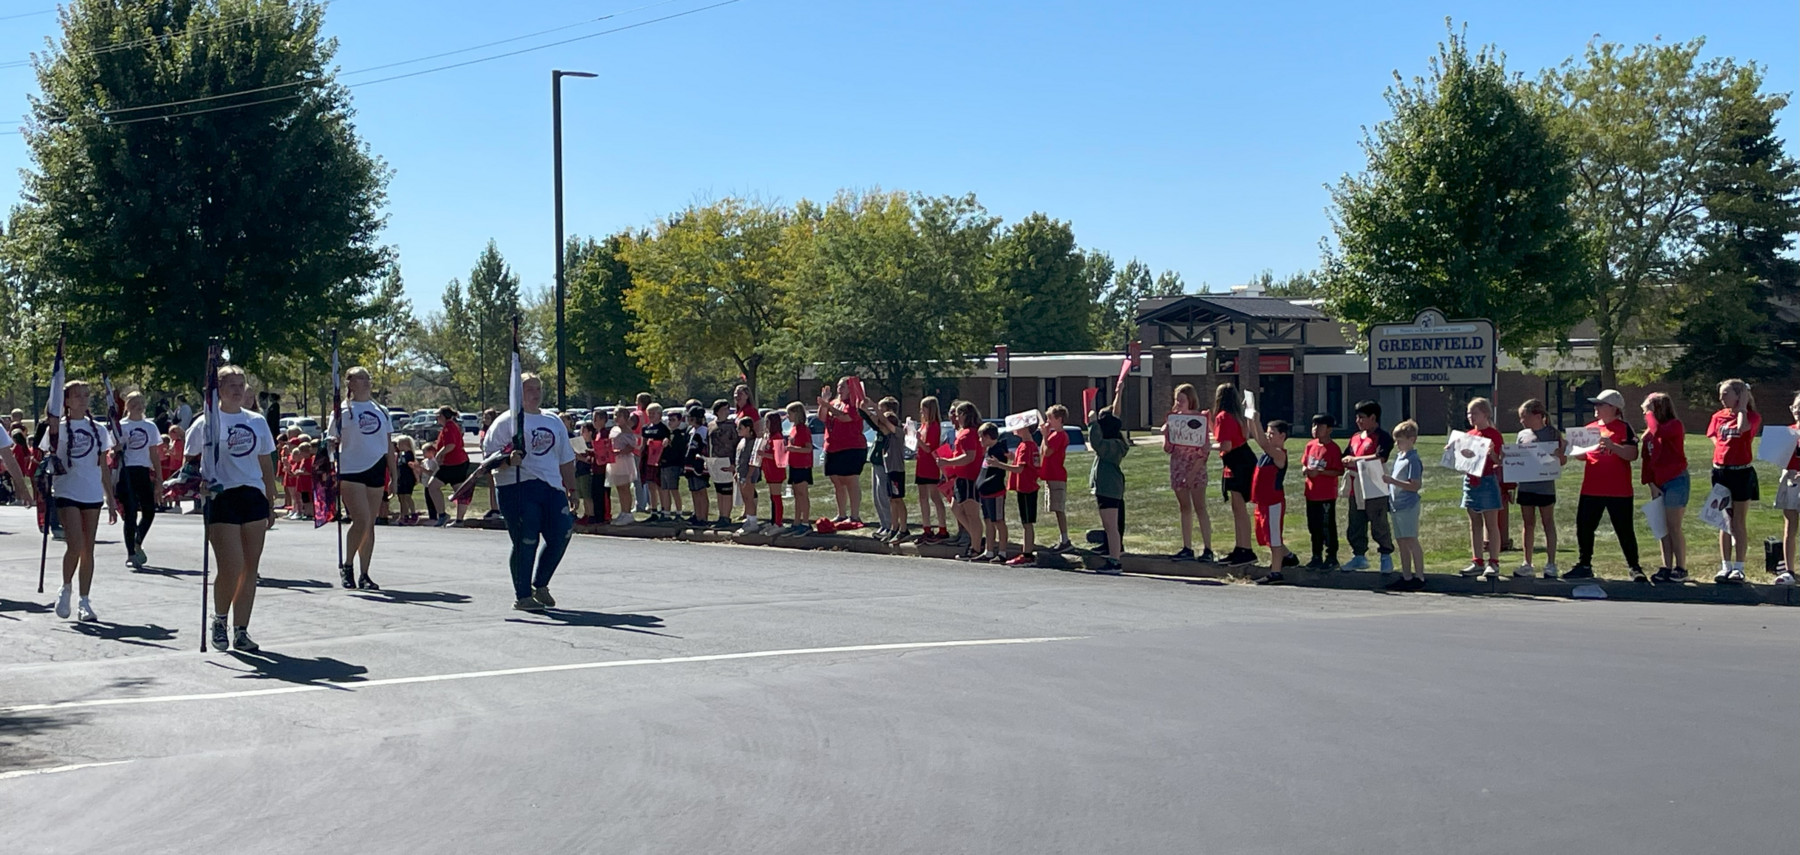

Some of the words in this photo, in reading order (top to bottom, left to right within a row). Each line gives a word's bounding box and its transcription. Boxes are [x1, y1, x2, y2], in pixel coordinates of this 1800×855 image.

[1378, 336, 1484, 352] GREENFIELD
[1377, 355, 1487, 370] ELEMENTARY
[1410, 373, 1450, 381] SCHOOL
